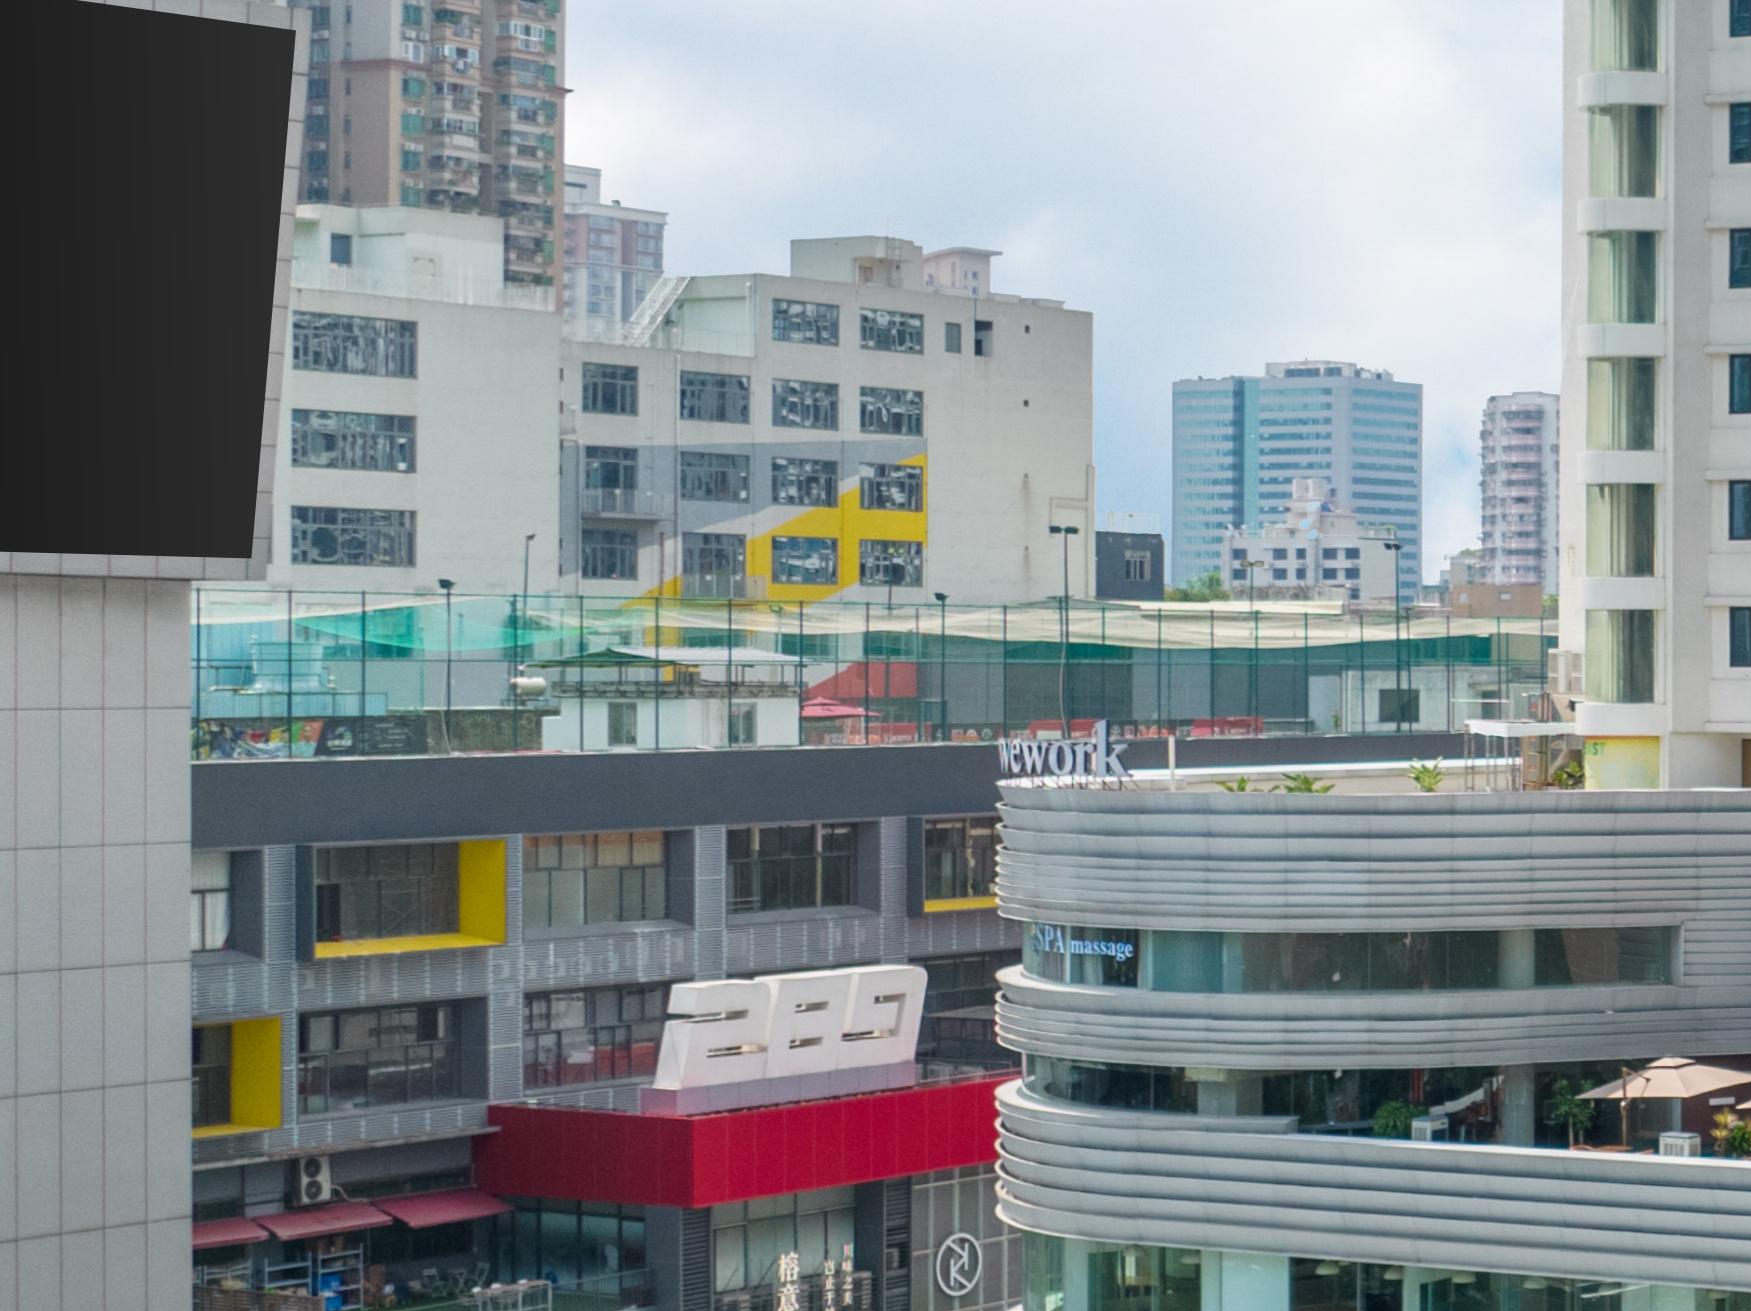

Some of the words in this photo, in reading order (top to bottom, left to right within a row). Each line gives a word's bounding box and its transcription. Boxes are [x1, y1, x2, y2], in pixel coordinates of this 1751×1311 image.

[998, 719, 1132, 777] wework
[1035, 924, 1065, 955] SPA
[1071, 939, 1133, 962] massage
